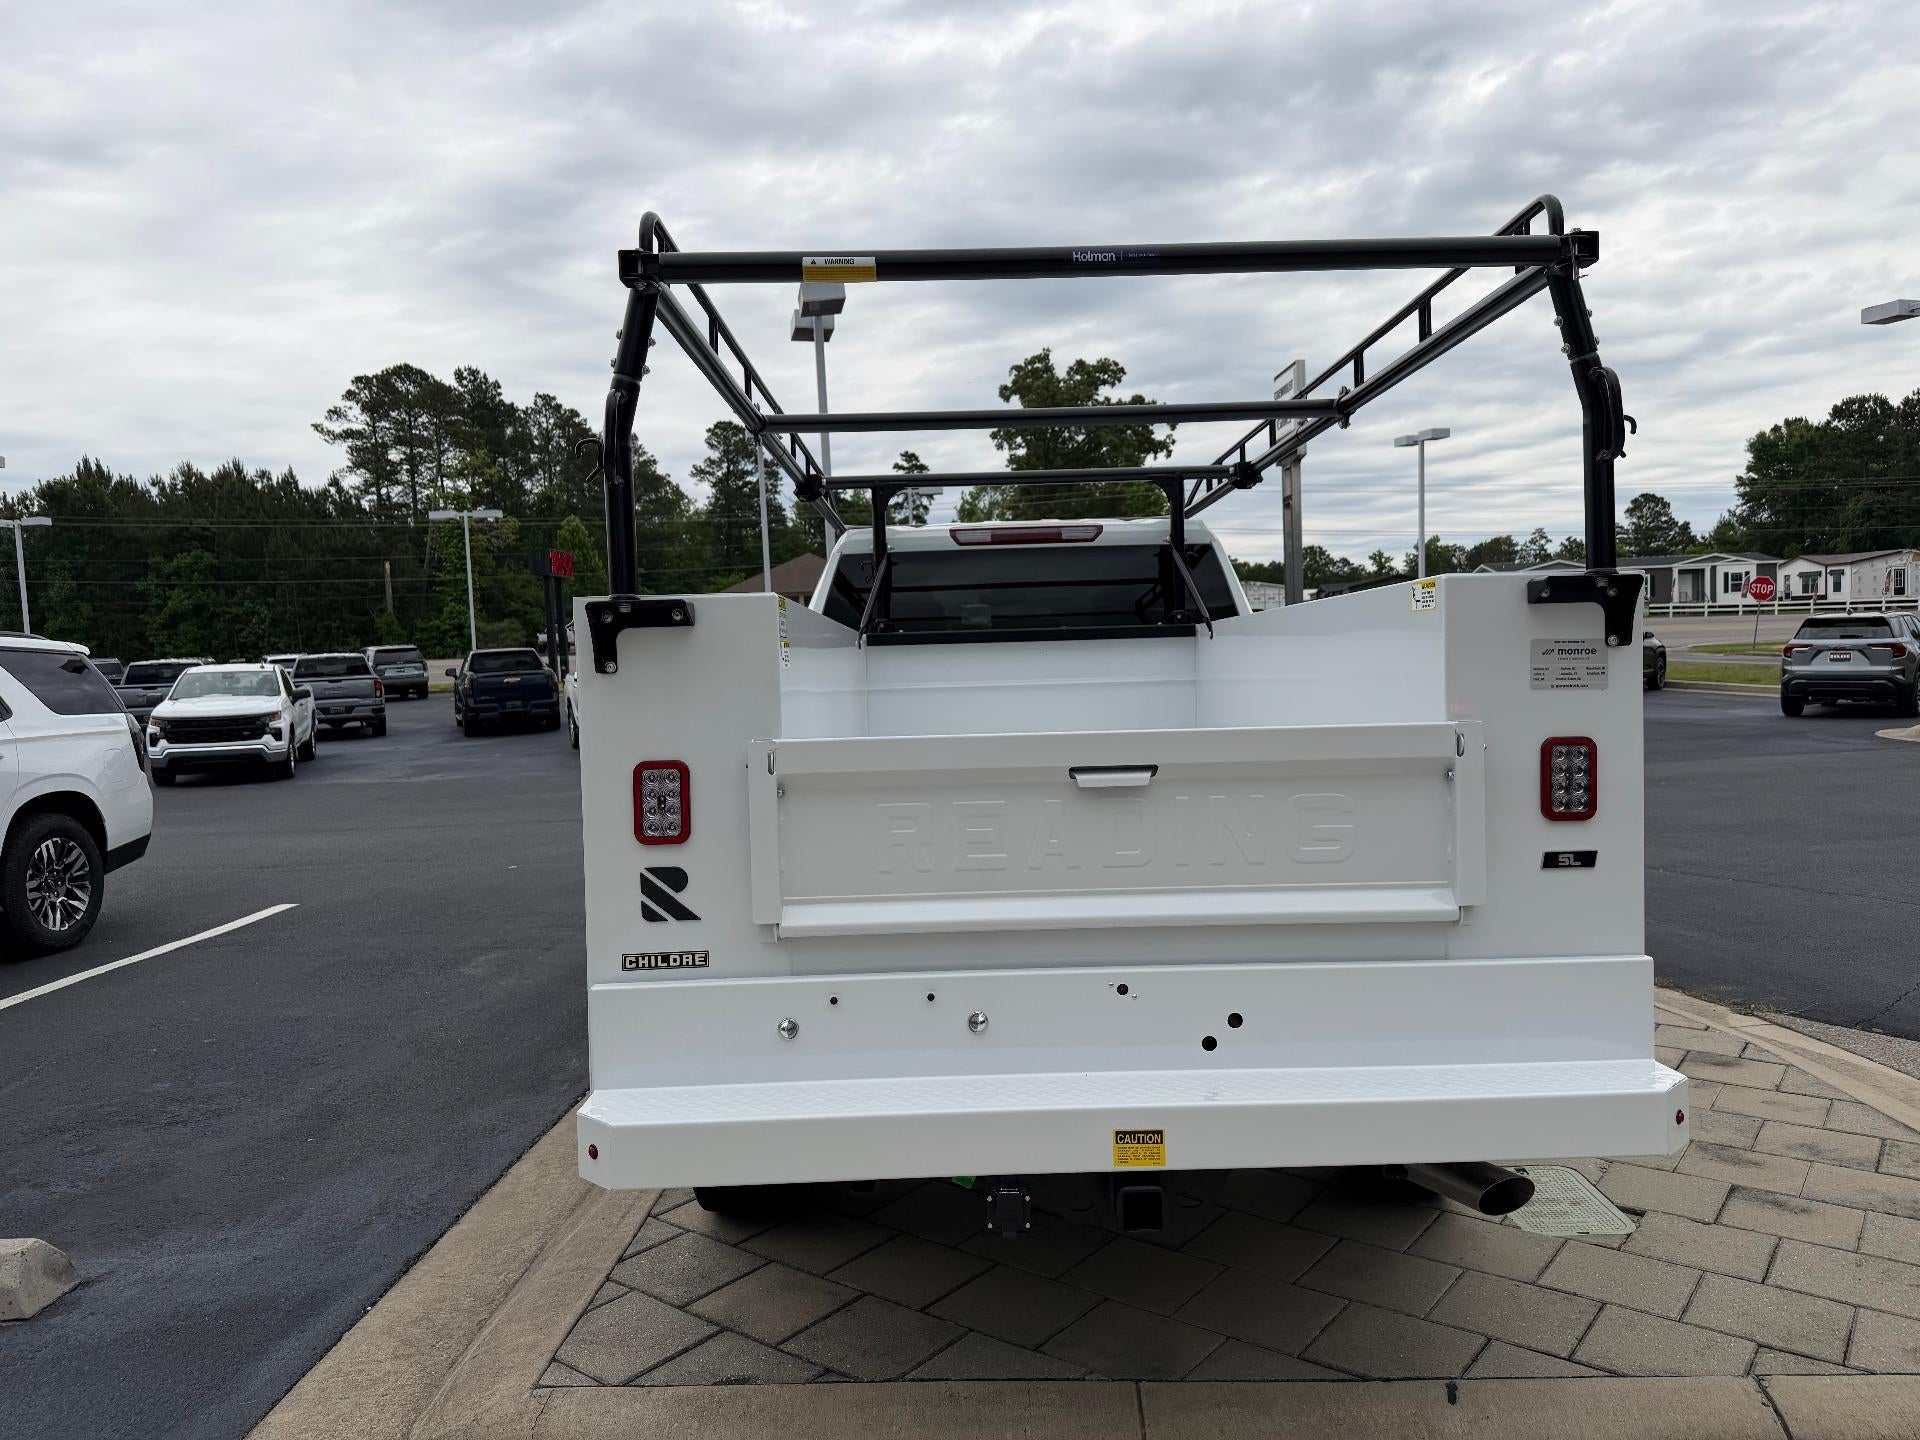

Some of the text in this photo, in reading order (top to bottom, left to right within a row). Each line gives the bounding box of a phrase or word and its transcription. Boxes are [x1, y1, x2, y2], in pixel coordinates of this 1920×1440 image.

[1072, 250, 1117, 262] Holman
[1750, 583, 1774, 594] STOP
[1557, 648, 1598, 656] monroe
[876, 792, 1358, 875] READING
[1558, 853, 1582, 866] SL
[1116, 1133, 1161, 1144] CAUTION
